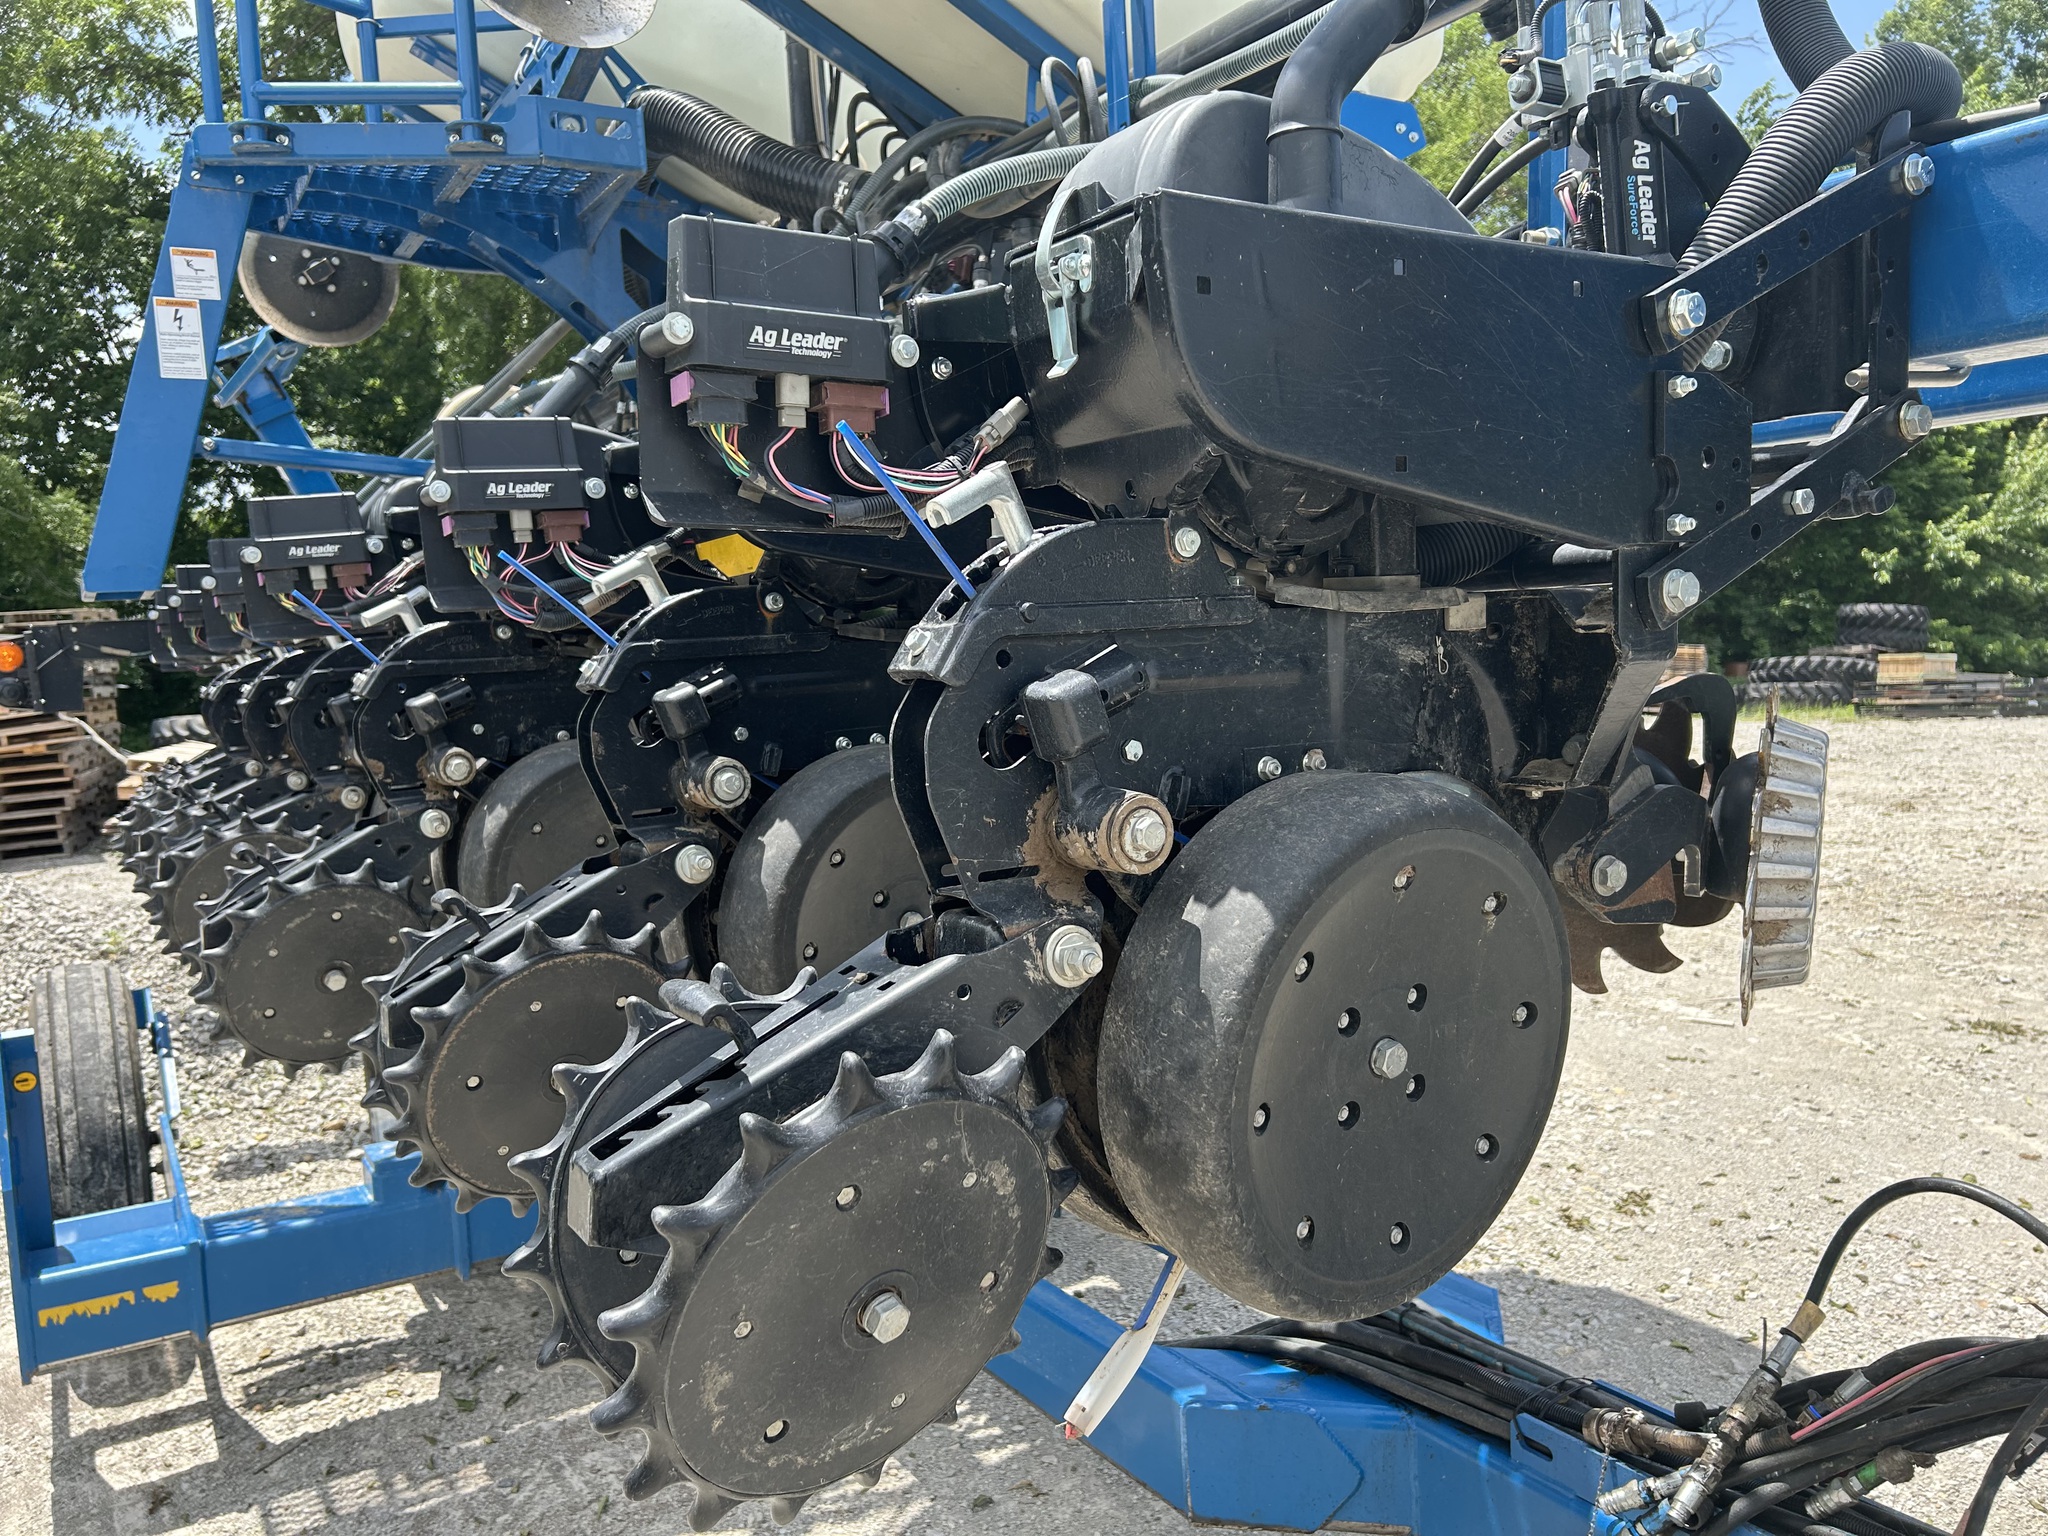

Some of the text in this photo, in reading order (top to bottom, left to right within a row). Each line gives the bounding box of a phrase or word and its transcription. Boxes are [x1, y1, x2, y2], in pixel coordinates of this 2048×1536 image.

[1632, 139, 1657, 246] Ag Leader
[1626, 175, 1640, 236] SureForce
[749, 325, 844, 350] Ag Leader
[791, 346, 833, 359] Technology
[486, 481, 551, 496] Ag Leader
[288, 546, 304, 557] Ag
[305, 543, 340, 555] Leader
